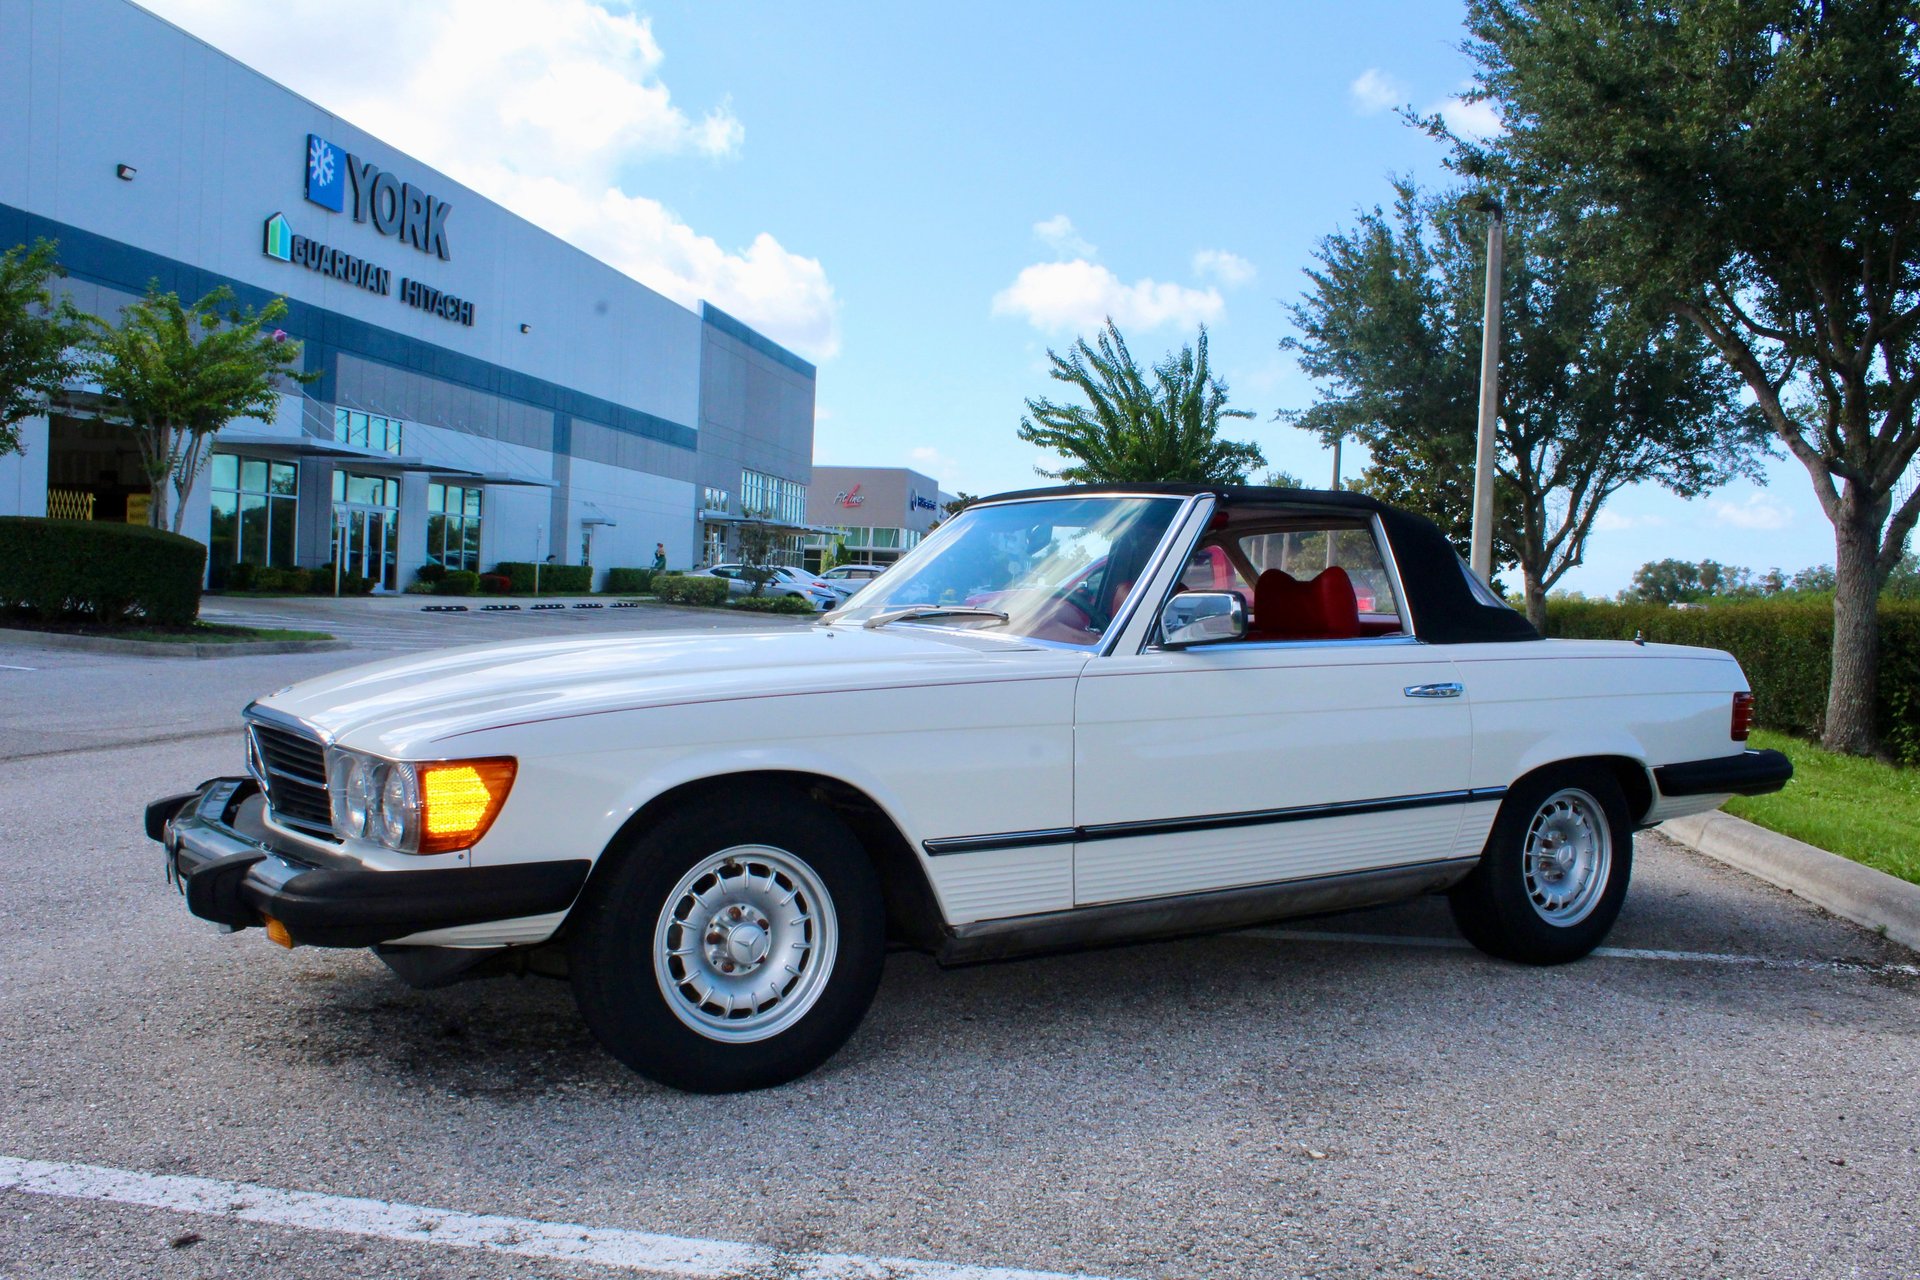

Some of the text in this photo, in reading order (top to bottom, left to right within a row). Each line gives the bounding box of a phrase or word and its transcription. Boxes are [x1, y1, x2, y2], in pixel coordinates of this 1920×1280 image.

[346, 153, 452, 261] YORK
[291, 234, 475, 327] GUARDIAN HITACHI
